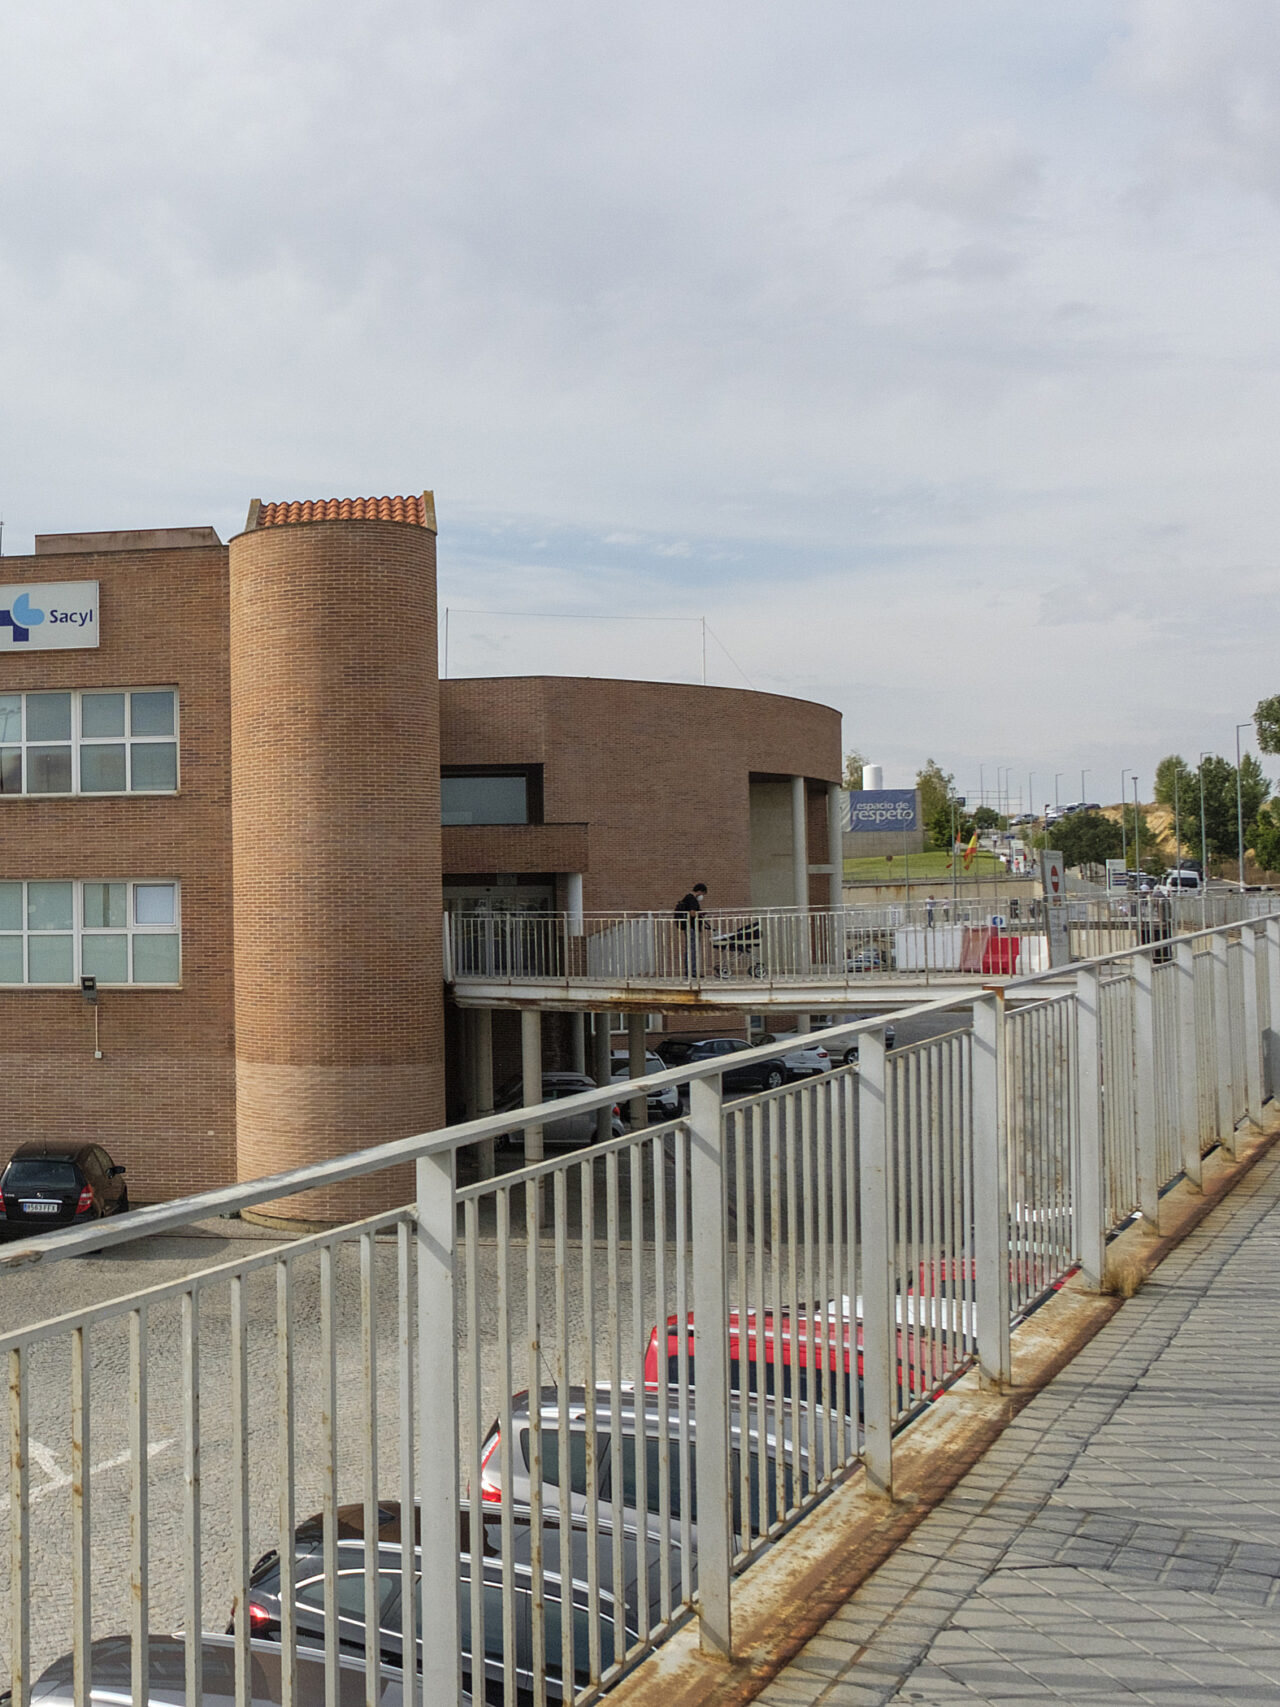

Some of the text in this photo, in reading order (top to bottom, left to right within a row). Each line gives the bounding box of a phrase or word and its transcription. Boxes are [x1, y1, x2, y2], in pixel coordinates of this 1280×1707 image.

[49, 609, 93, 627] Sacyl
[856, 801, 909, 811] espacio de
[853, 809, 914, 823] respeto
